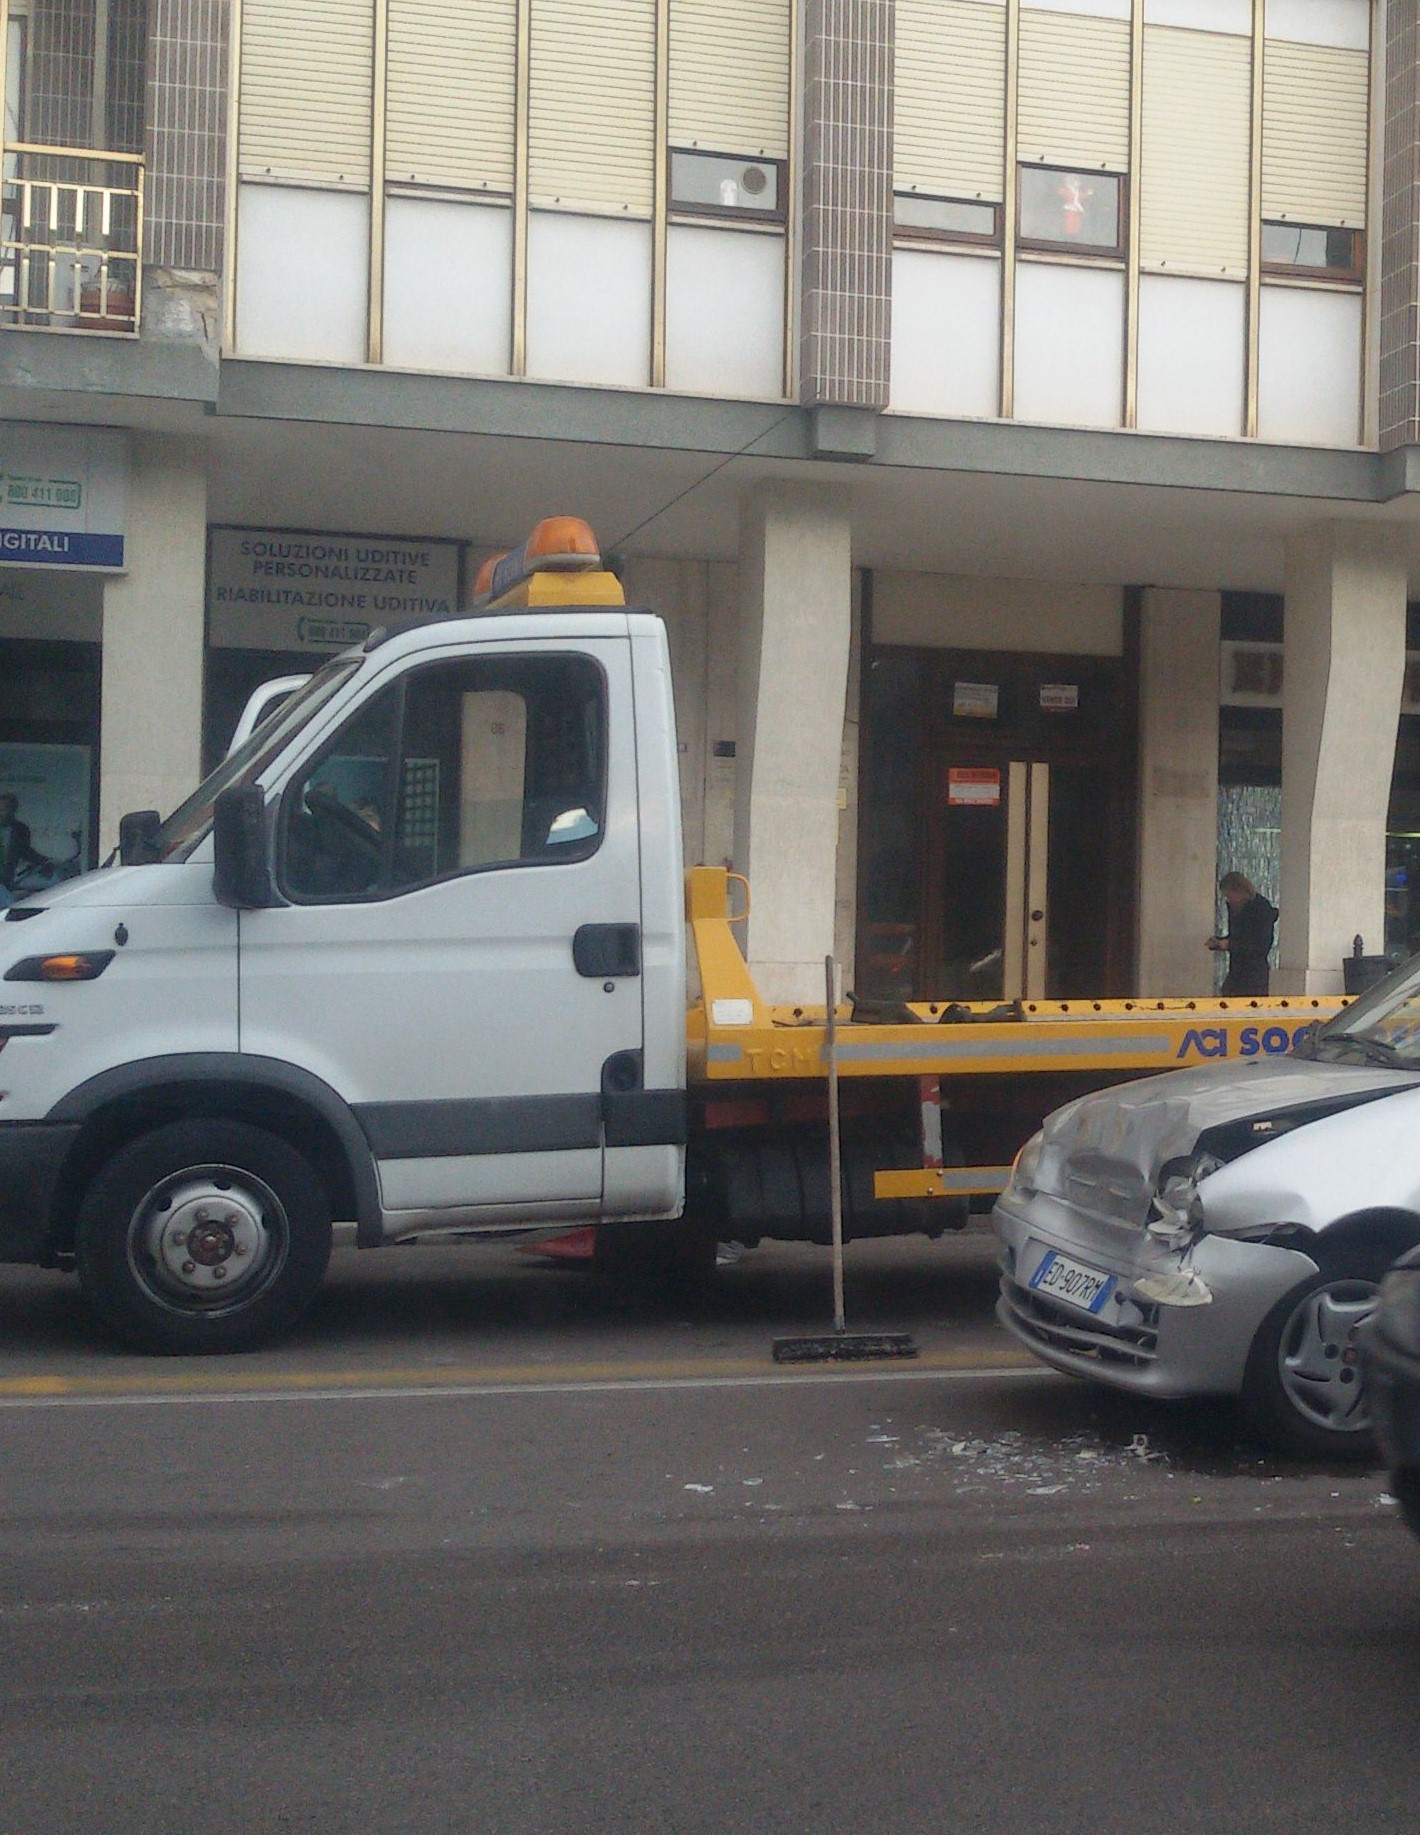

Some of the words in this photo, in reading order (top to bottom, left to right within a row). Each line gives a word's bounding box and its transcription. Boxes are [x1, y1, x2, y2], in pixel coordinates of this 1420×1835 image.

[240, 541, 350, 562] SOLUZIONI
[356, 549, 431, 567] UDITIVE
[252, 561, 418, 585] PERSONALIZZATE
[216, 586, 367, 610] RIABILITAZIONE
[373, 597, 451, 614] UDITIVA
